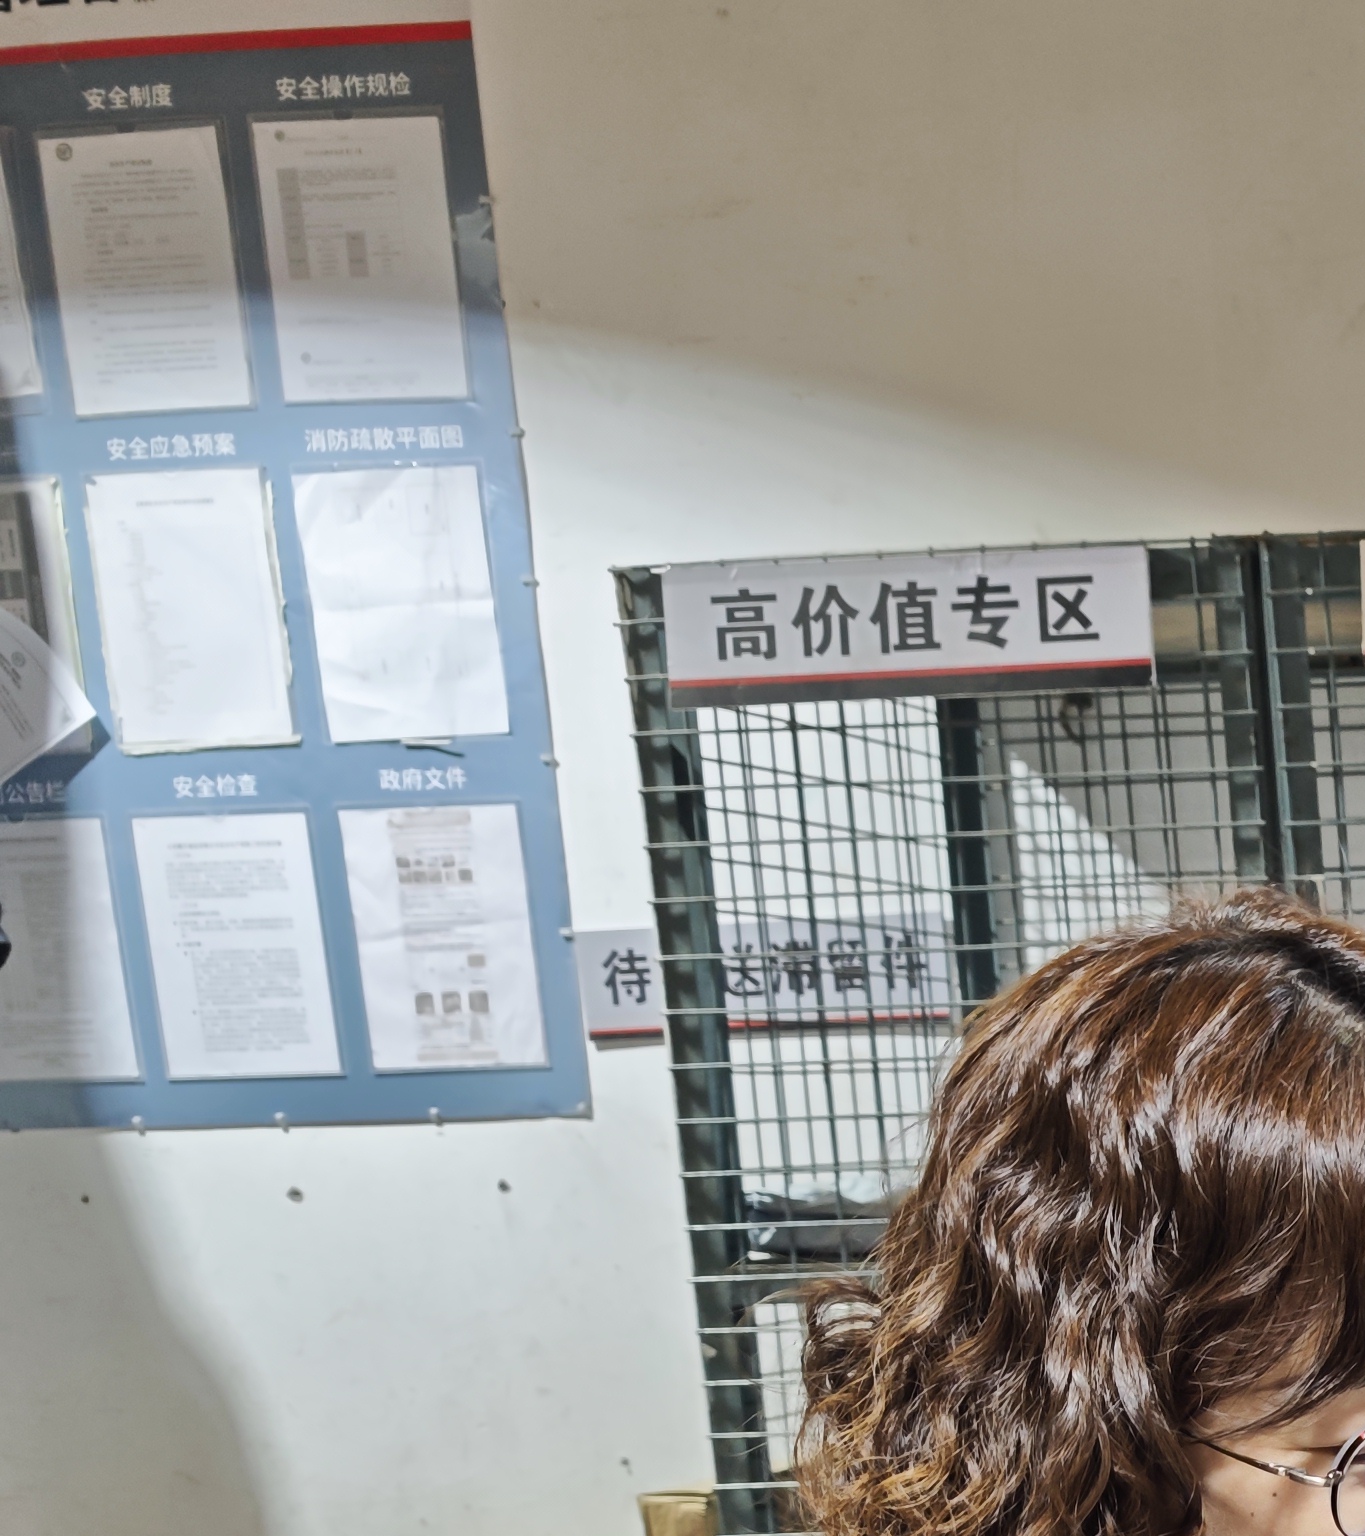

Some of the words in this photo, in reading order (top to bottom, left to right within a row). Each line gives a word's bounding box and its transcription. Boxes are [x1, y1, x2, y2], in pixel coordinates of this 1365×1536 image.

[84, 83, 173, 111] 安全制度
[275, 73, 411, 101] 安全操作规检
[106, 432, 236, 461] 安全应急预案
[304, 425, 464, 452] 消防疏散平面图
[710, 574, 1100, 661] 高价值专区
[0, 780, 66, 804] 公告栏
[172, 773, 259, 798] 安全检查
[379, 768, 467, 792] 政府文件
[602, 928, 928, 1006] 待送滞留件
